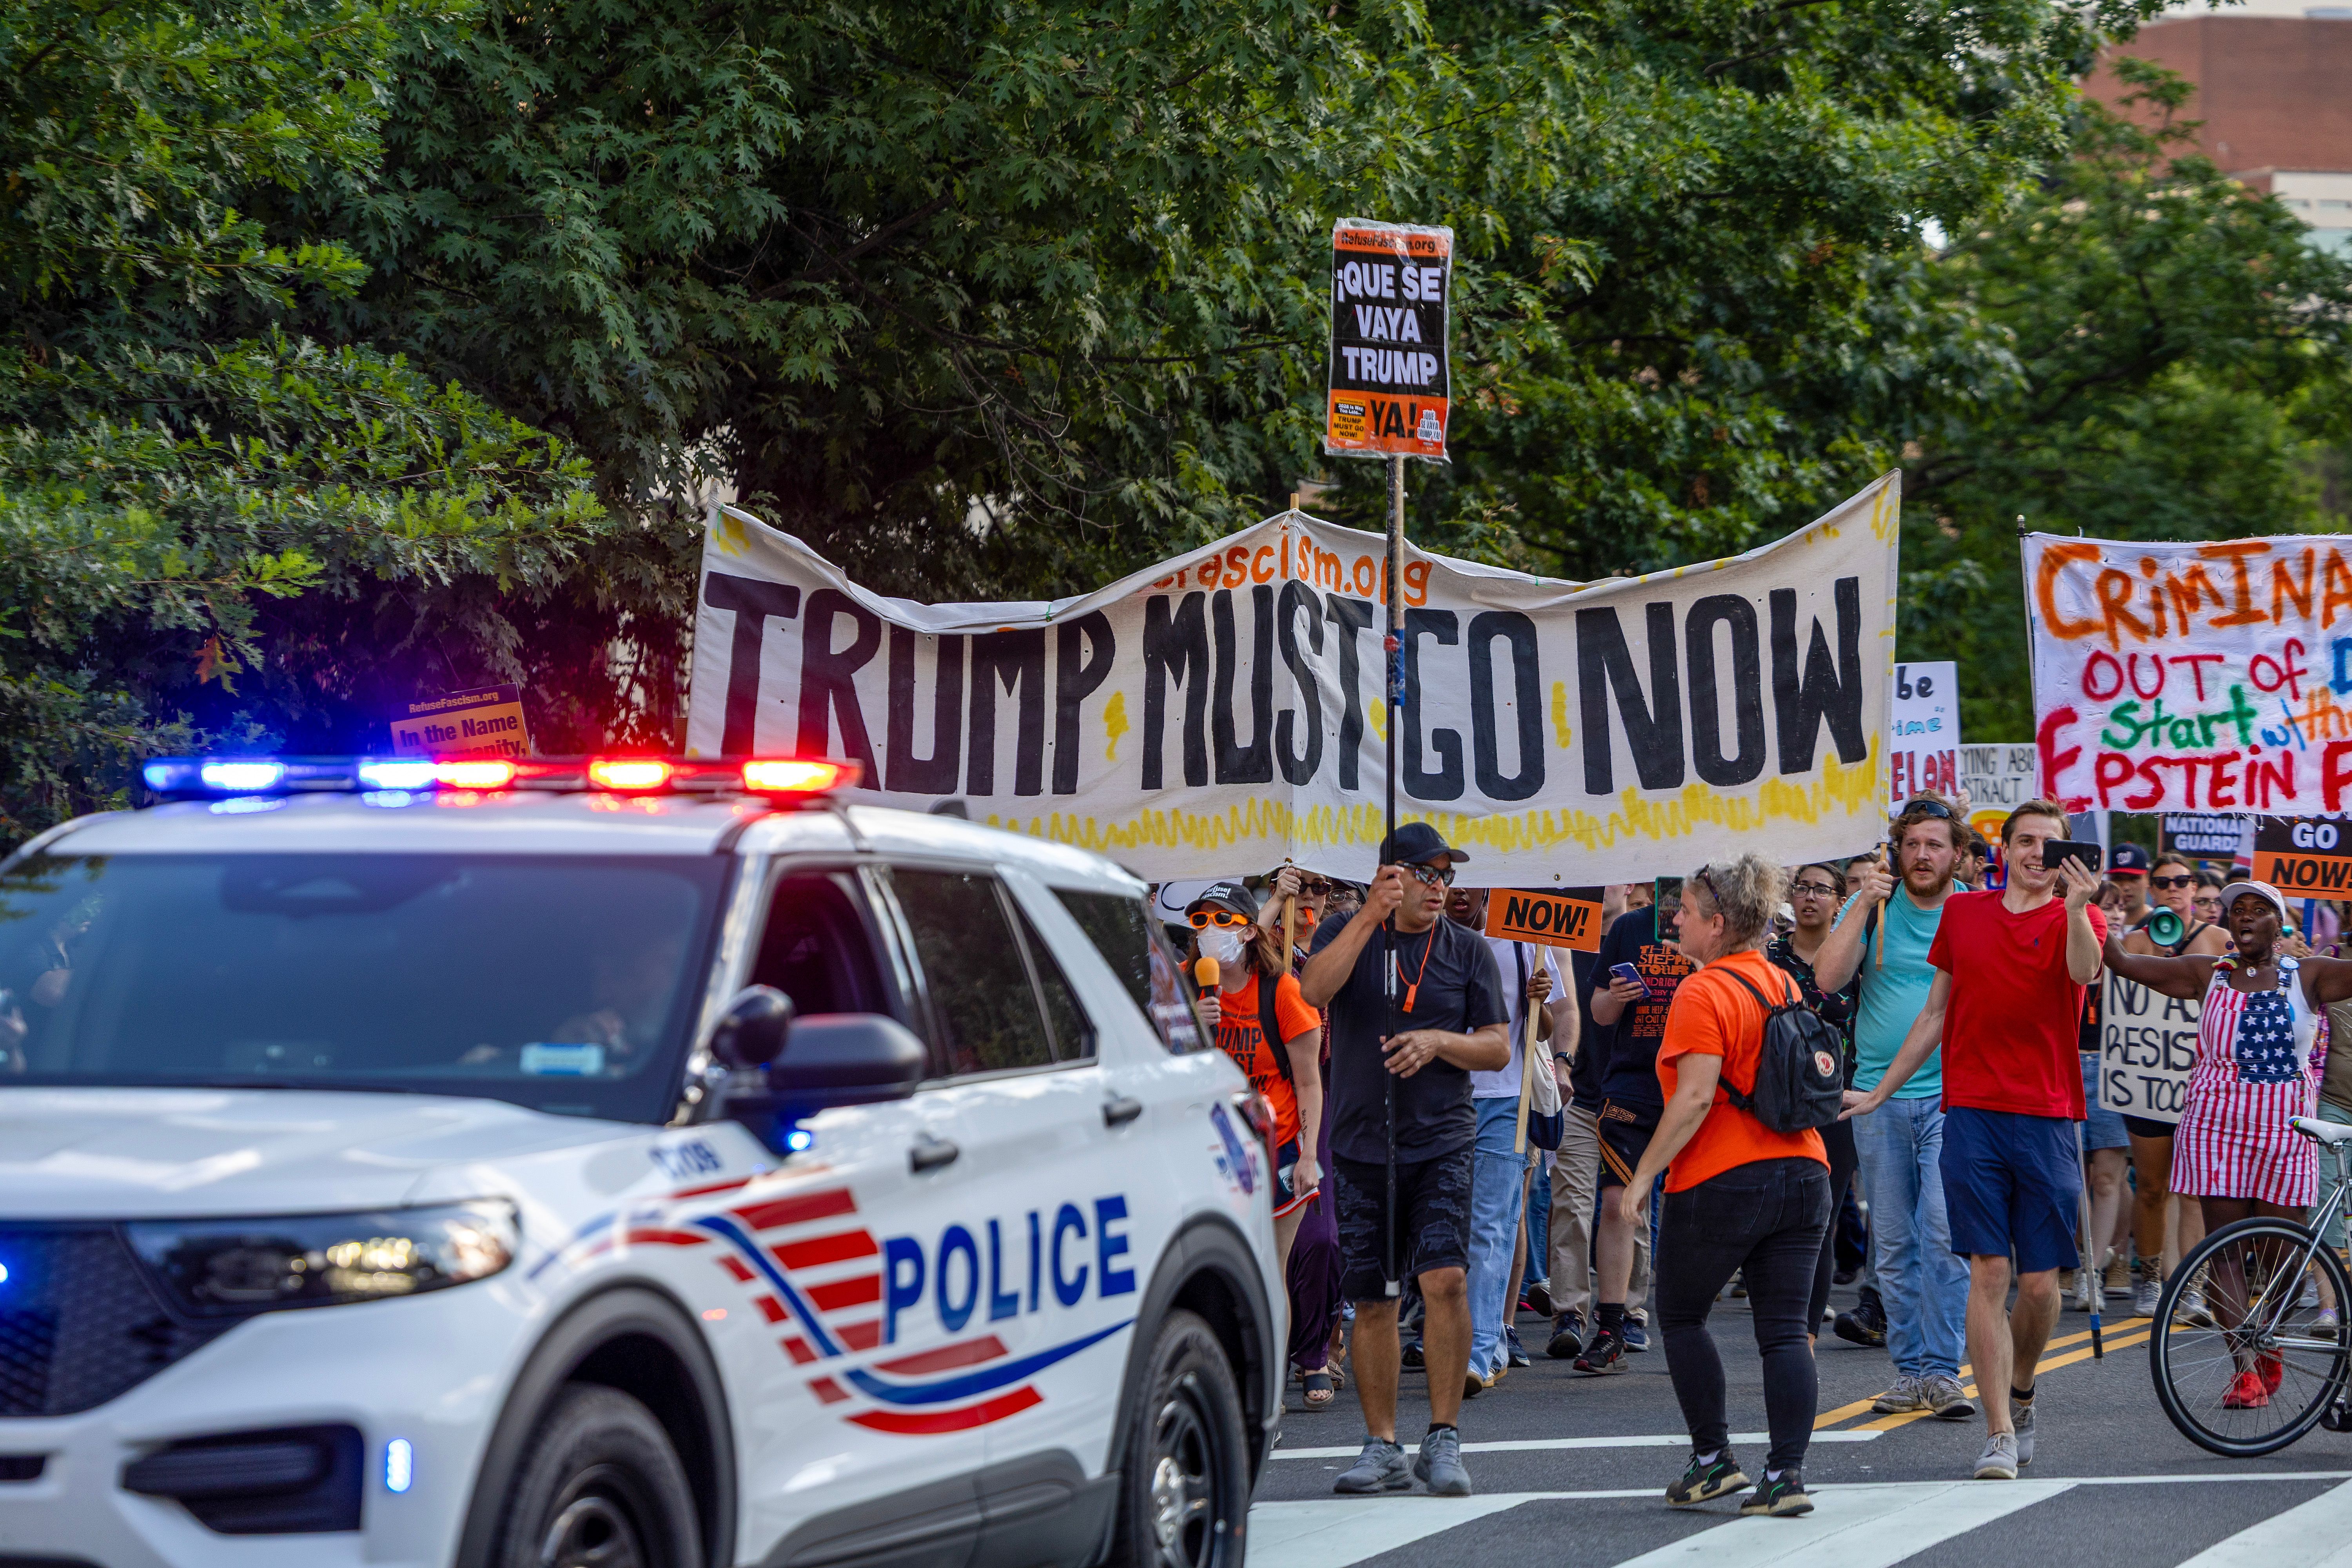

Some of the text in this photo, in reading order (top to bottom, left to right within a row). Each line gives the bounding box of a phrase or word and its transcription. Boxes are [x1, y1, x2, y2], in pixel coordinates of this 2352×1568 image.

[1341, 231, 1436, 252] RefuseFascm.org
[1337, 261, 1441, 302] ¡QUE SE
[1355, 304, 1421, 343] VAYA
[1342, 347, 1437, 386] TRUMP
[1370, 399, 1417, 438] YA!
[1418, 428, 1432, 438] TRUMP
[1421, 420, 1438, 430] SE VAYA
[705, 571, 1867, 802] TRUMP MUST GO NOW
[2082, 649, 2225, 702] OUT
[409, 691, 499, 714] RefuseFascism.org
[2100, 683, 2259, 750] Start
[2284, 686, 2352, 742] th
[399, 715, 518, 747] In the Name
[1891, 749, 1956, 802] ELON
[1960, 747, 1997, 775] YING
[2165, 816, 2241, 835] NATIONA
[2292, 822, 2339, 849] GO
[1504, 896, 1590, 937] NOW!
[1637, 964, 1689, 975] TOUR
[2110, 971, 2150, 1016] NO
[2103, 1067, 2186, 1112] IS TOO
[1608, 1107, 1634, 1119] CAUTION
[882, 1192, 1136, 1344] POLICE
